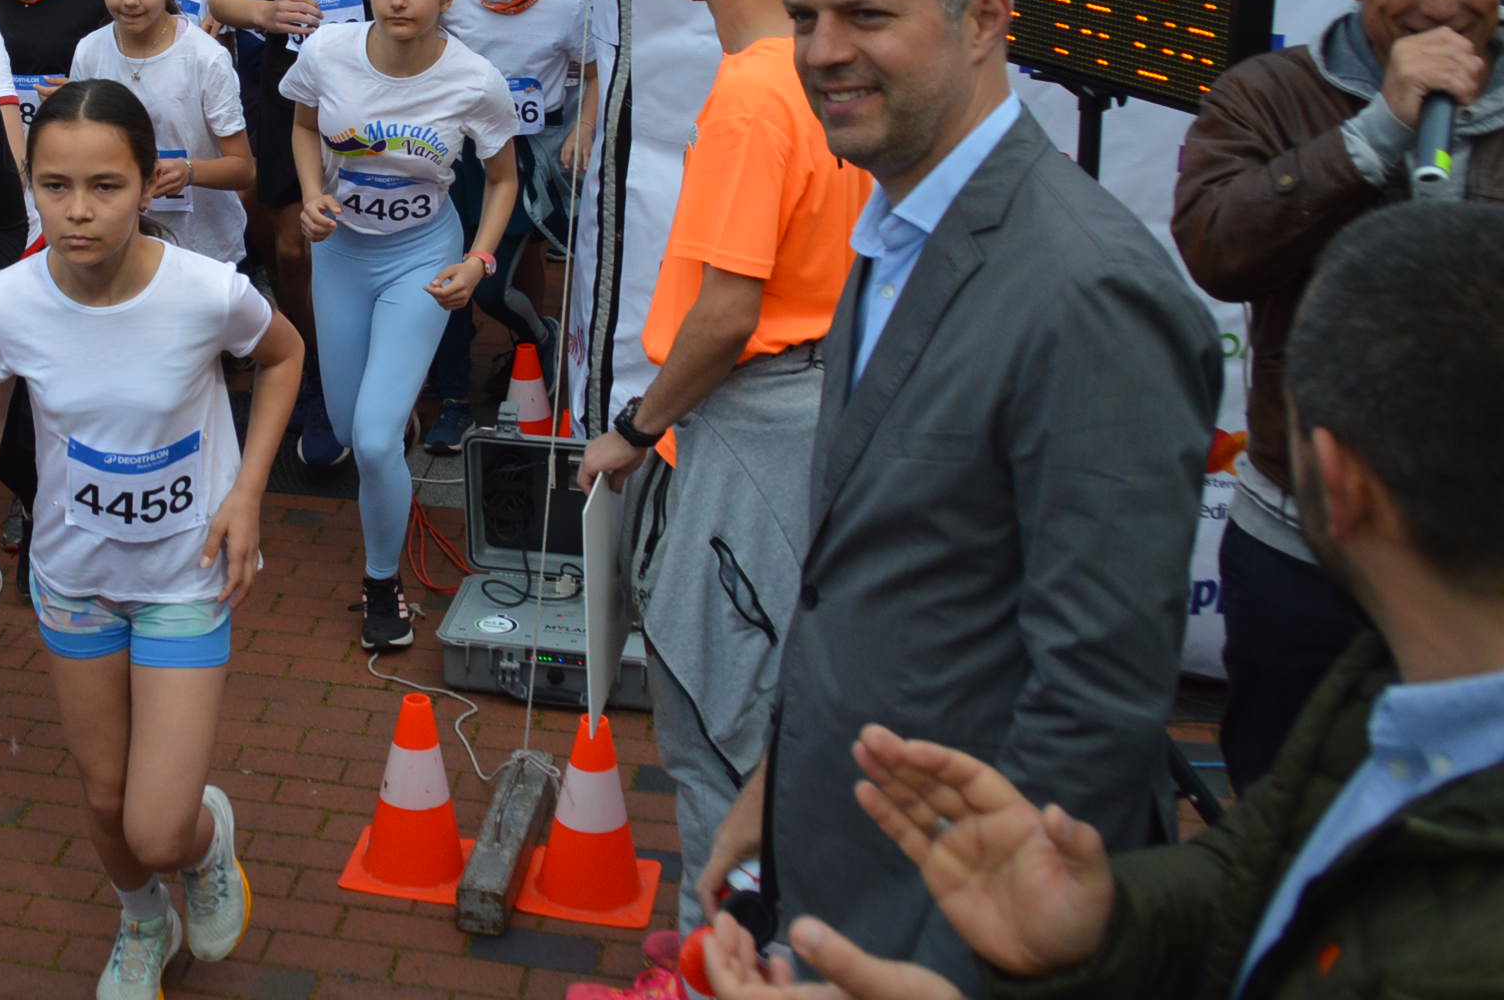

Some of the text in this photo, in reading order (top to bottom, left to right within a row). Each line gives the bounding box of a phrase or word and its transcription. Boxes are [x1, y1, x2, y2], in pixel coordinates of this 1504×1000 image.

[364, 120, 449, 157] Marathon
[402, 139, 443, 166] Varna
[343, 194, 432, 221] 4463
[117, 449, 169, 465] DECATHLON
[74, 475, 194, 525] 4458
